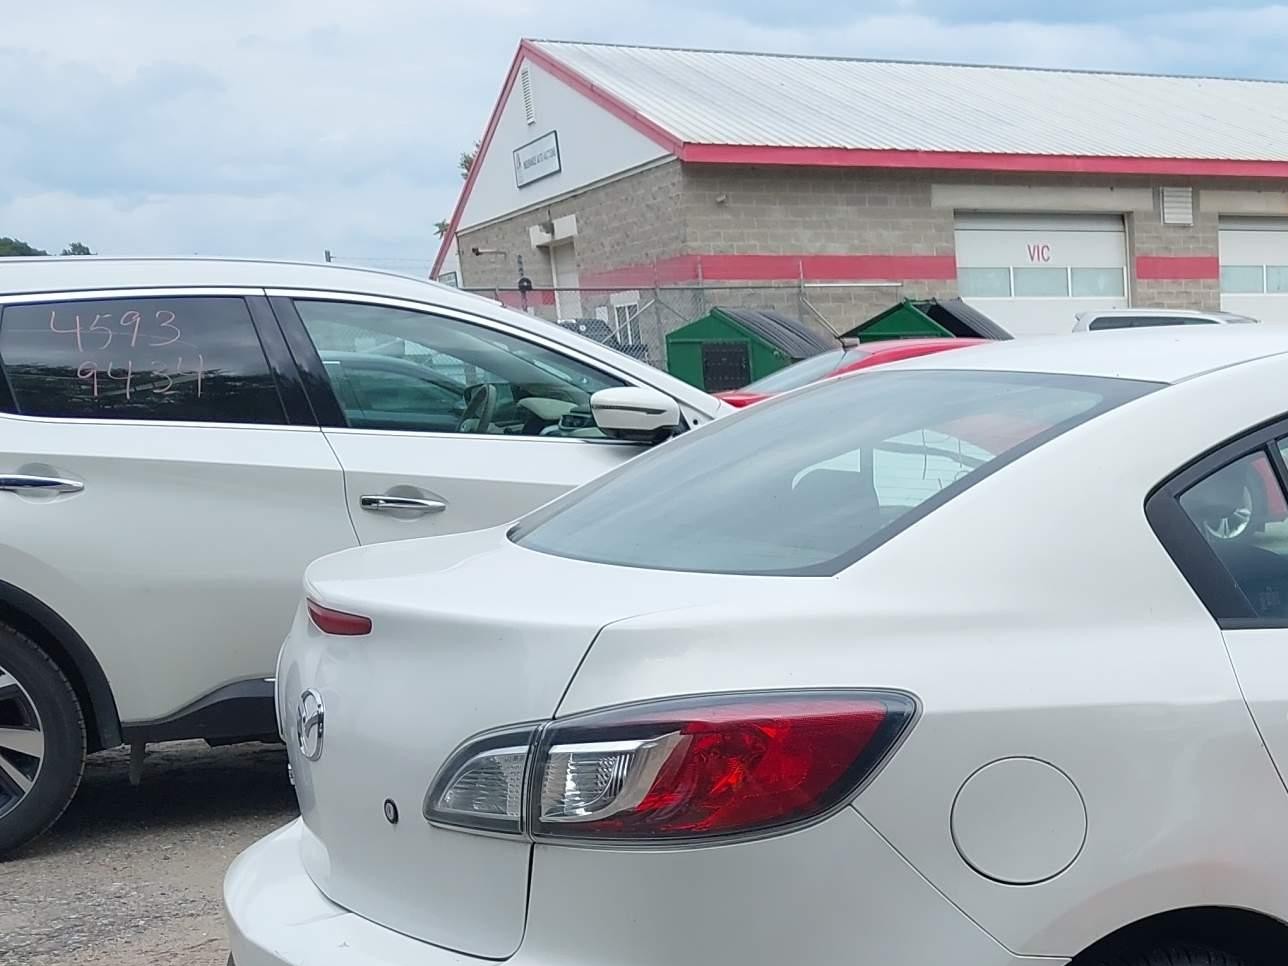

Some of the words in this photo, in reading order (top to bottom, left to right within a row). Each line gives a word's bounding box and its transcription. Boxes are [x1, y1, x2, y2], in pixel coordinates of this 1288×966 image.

[1027, 244, 1050, 262] VIC
[50, 310, 181, 352] 4593
[77, 354, 204, 400] 9434
